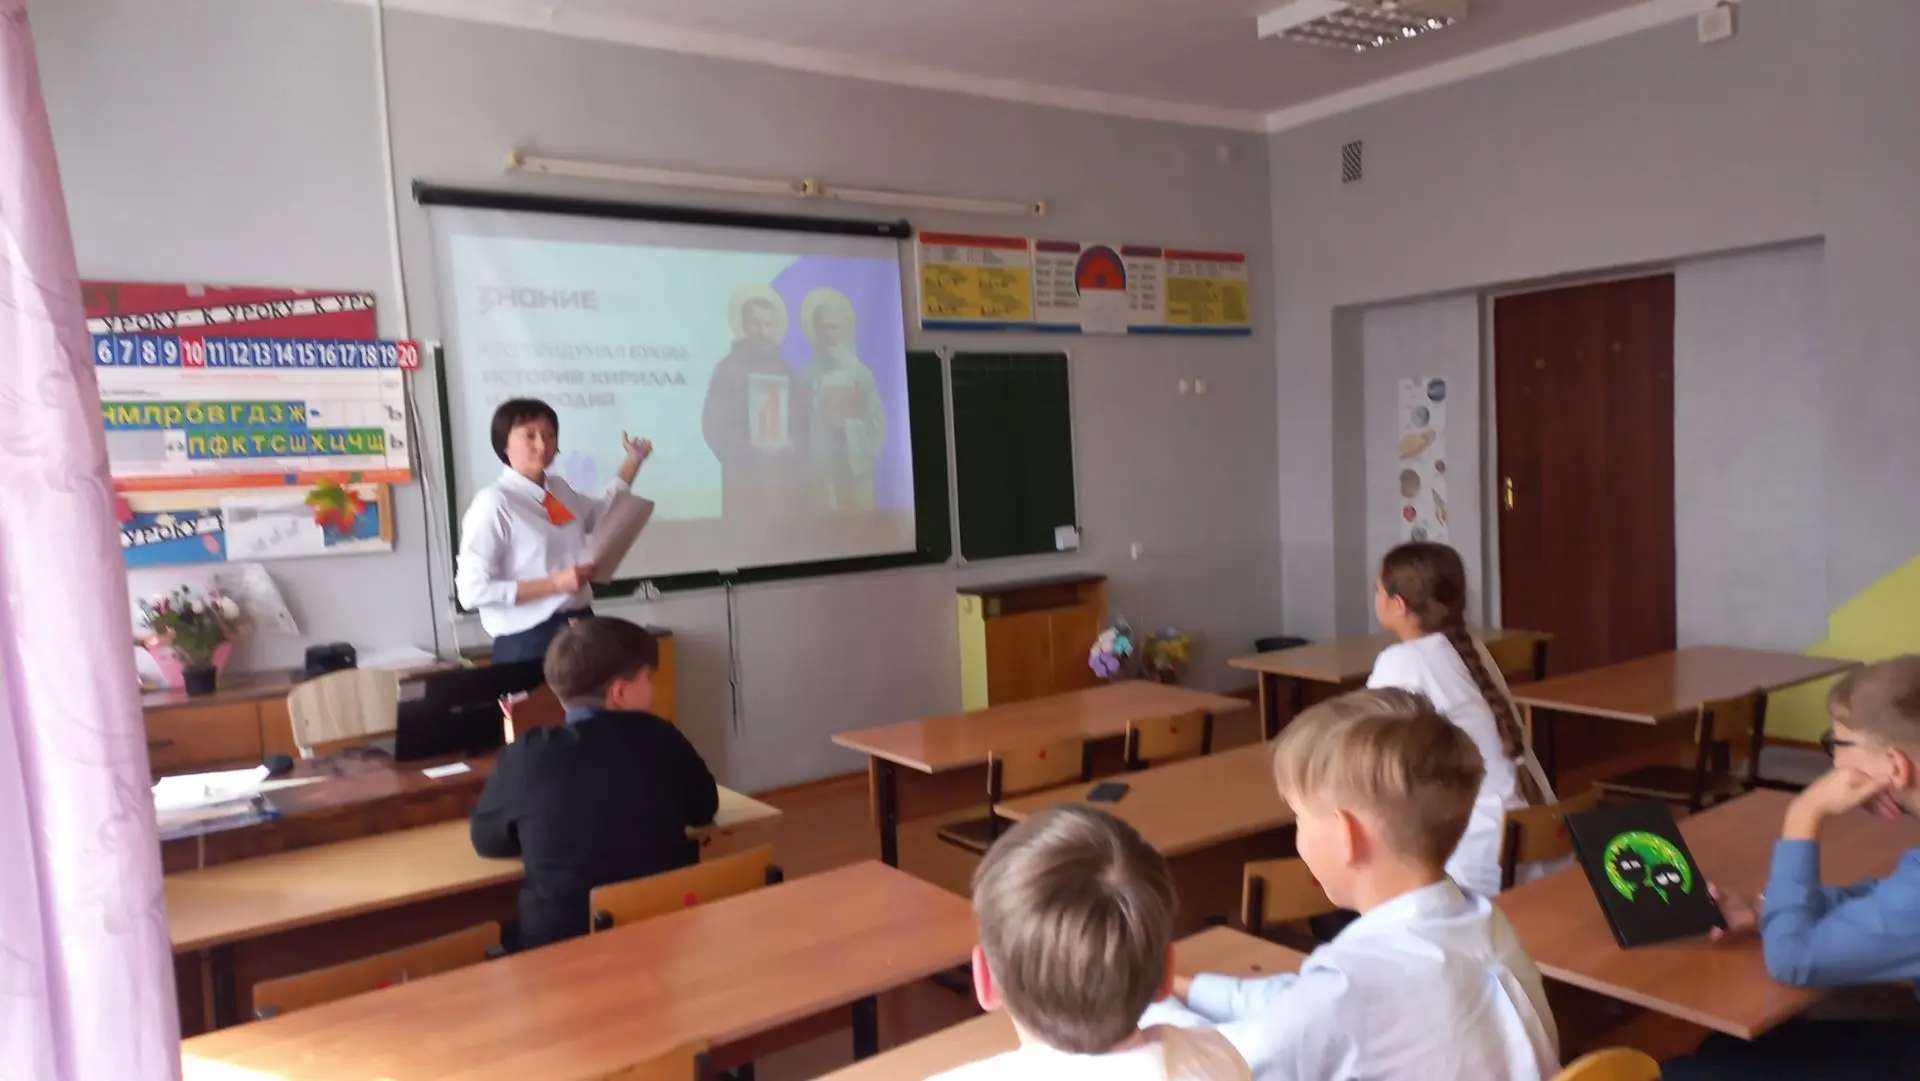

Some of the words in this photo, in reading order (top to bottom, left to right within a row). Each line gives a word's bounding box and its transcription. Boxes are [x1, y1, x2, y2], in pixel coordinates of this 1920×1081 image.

[98, 339, 113, 364] 6
[119, 340, 134, 364] 7
[141, 339, 157, 364] 8
[163, 339, 179, 364] 9
[183, 340, 203, 365] 10
[206, 340, 226, 365] 11
[229, 340, 249, 365] 12
[251, 340, 272, 365] 13
[273, 341, 293, 365] 14
[296, 341, 315, 365] 15
[317, 341, 336, 366] 16
[338, 341, 356, 366] 17
[359, 342, 377, 366] 18
[379, 342, 397, 366] 19
[399, 342, 418, 367] 20
[483, 369, 584, 385] ИСТОРИЯ
[590, 370, 688, 386] КИРИЛЛА
